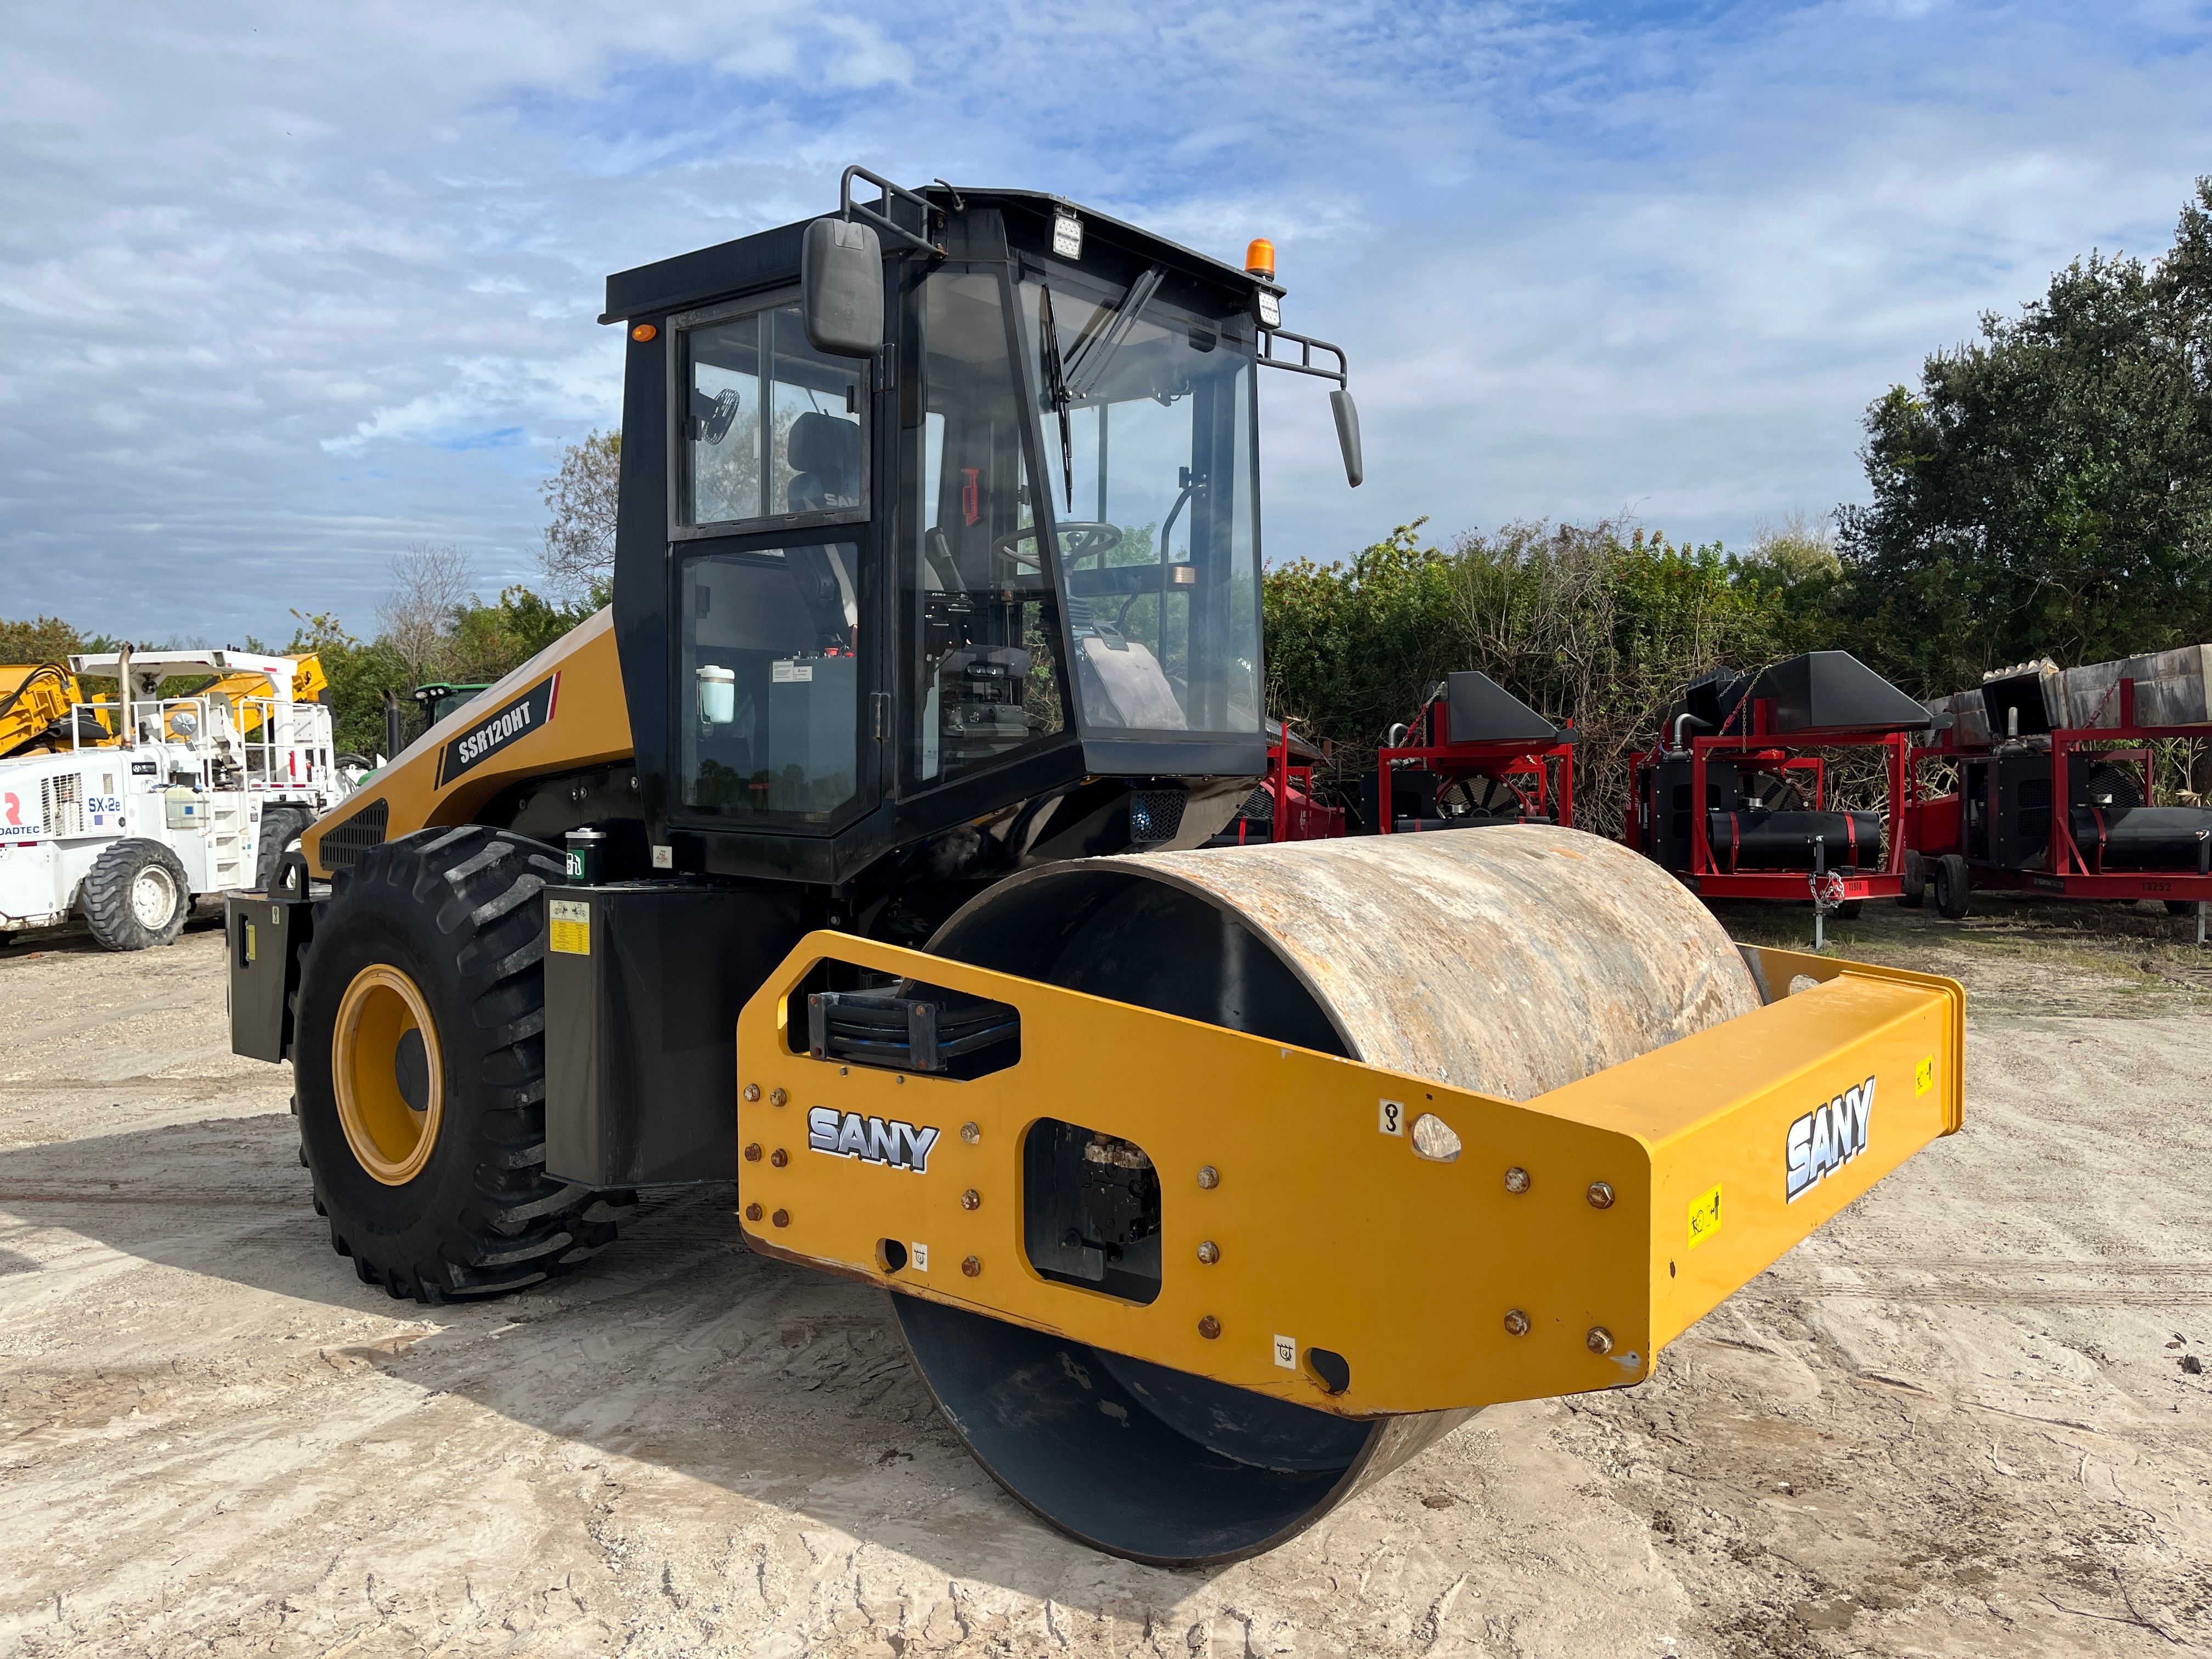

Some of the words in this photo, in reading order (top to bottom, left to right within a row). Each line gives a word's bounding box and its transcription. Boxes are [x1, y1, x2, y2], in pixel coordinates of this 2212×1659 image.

[459, 701, 531, 763] SSR120HT
[2141, 882, 2171, 891] 13252
[807, 1105, 941, 1175] SANY
[1786, 1075, 1875, 1205] SANY
